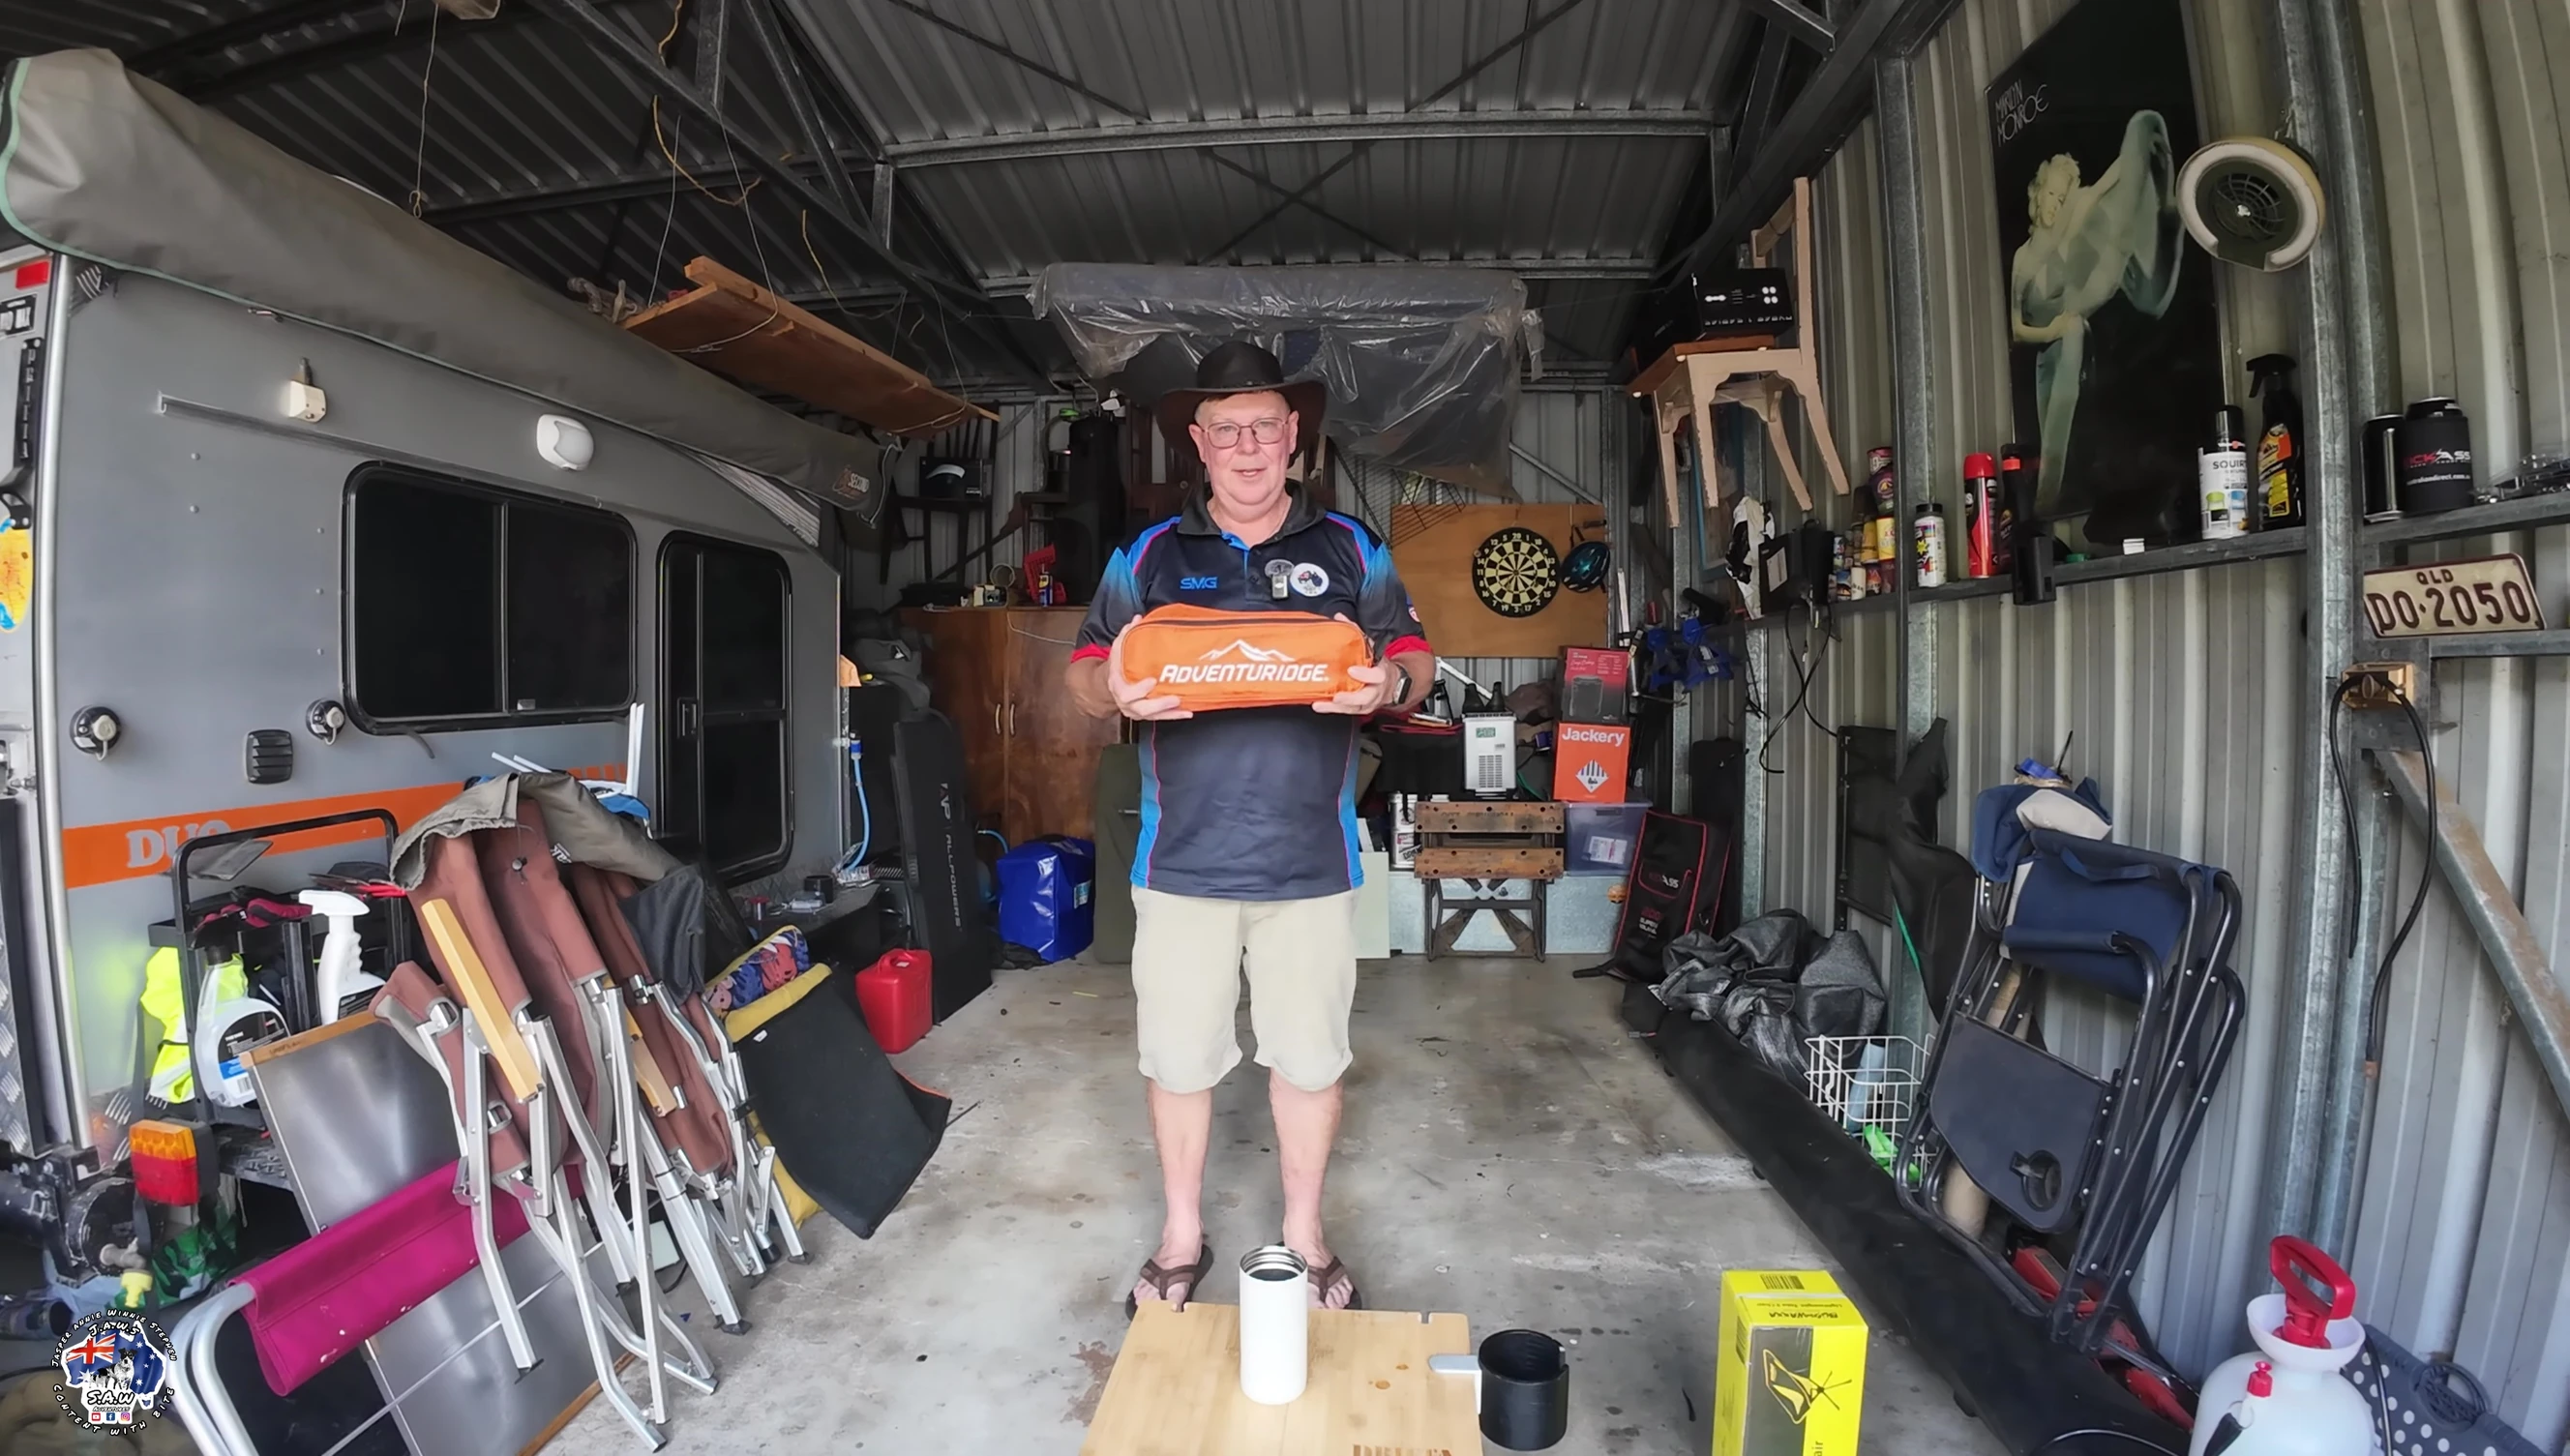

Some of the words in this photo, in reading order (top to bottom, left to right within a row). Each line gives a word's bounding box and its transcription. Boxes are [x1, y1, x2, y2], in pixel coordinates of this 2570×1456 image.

[1997, 84, 2049, 147] MONROE
[1180, 577, 1218, 589] SMG
[2416, 569, 2454, 585] QLD
[1159, 664, 1329, 683] ADVENTURIDGE
[1562, 728, 1626, 747] Jackery
[945, 834, 962, 928] ALLPOWERS
